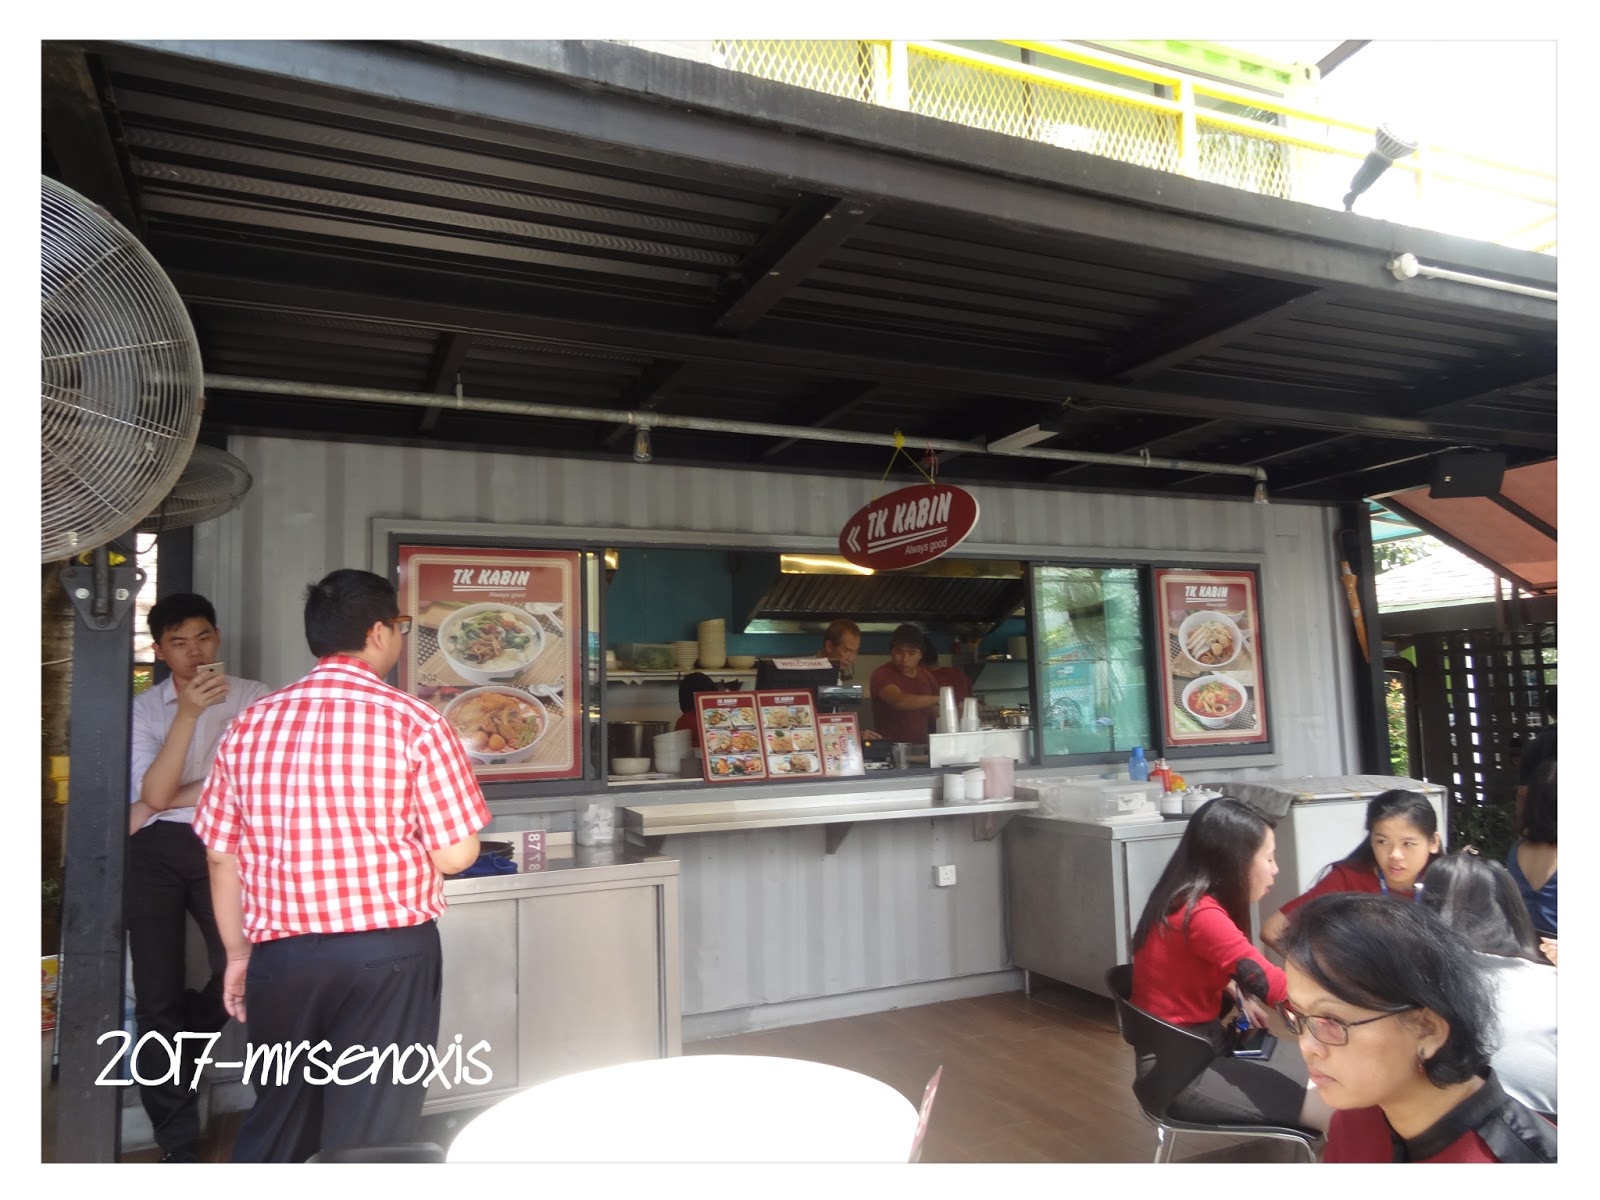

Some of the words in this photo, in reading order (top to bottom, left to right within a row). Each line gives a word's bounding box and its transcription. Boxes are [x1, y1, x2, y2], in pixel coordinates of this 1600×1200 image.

[867, 508, 889, 540] TK
[892, 491, 953, 533] KABIN
[904, 544, 929, 556] Always
[929, 537, 948, 553] good
[453, 568, 475, 585] TK
[478, 569, 530, 585] KABIN
[1185, 585, 1198, 598] TK
[1199, 585, 1229, 598] KABIN
